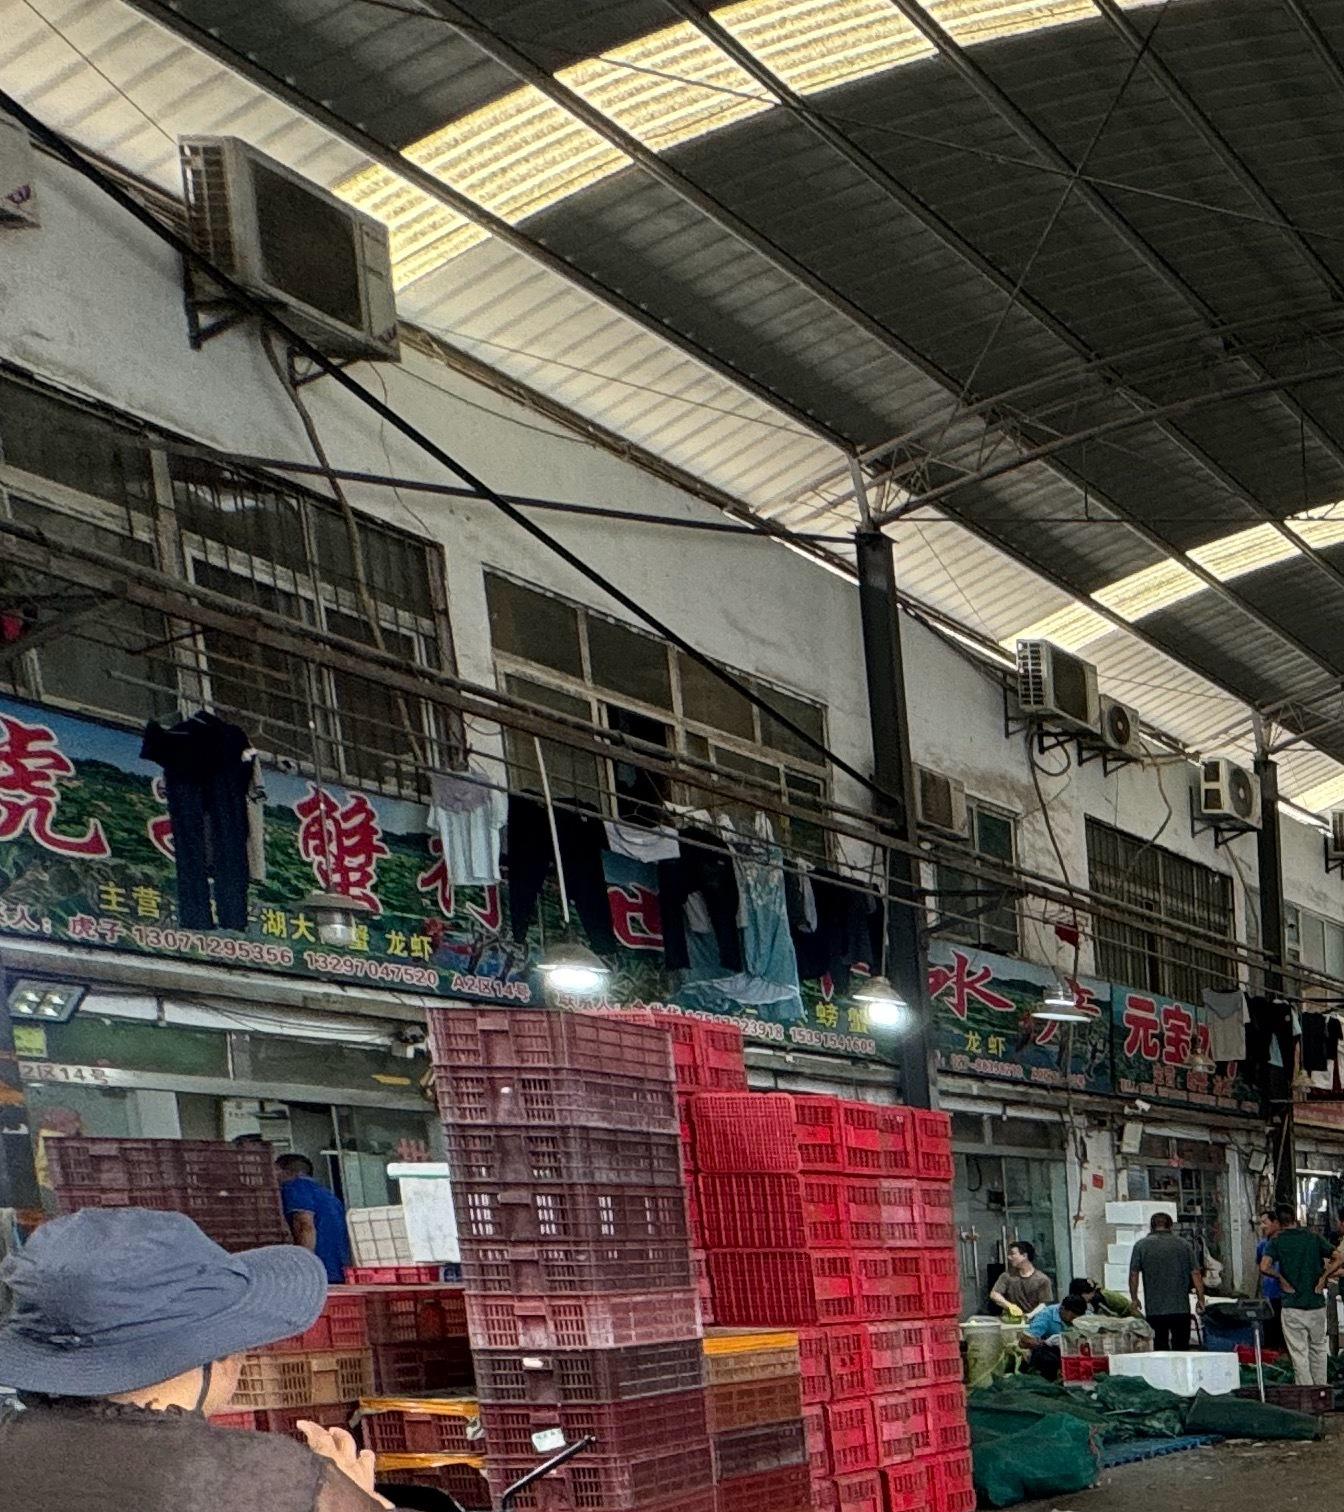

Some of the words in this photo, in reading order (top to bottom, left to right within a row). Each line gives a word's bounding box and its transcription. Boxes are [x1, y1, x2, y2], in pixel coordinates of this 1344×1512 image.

[67, 911, 125, 943] 虎子
[131, 923, 294, 966] 13071295356
[303, 949, 440, 991] 13297047520
[385, 927, 433, 962] 龙虾
